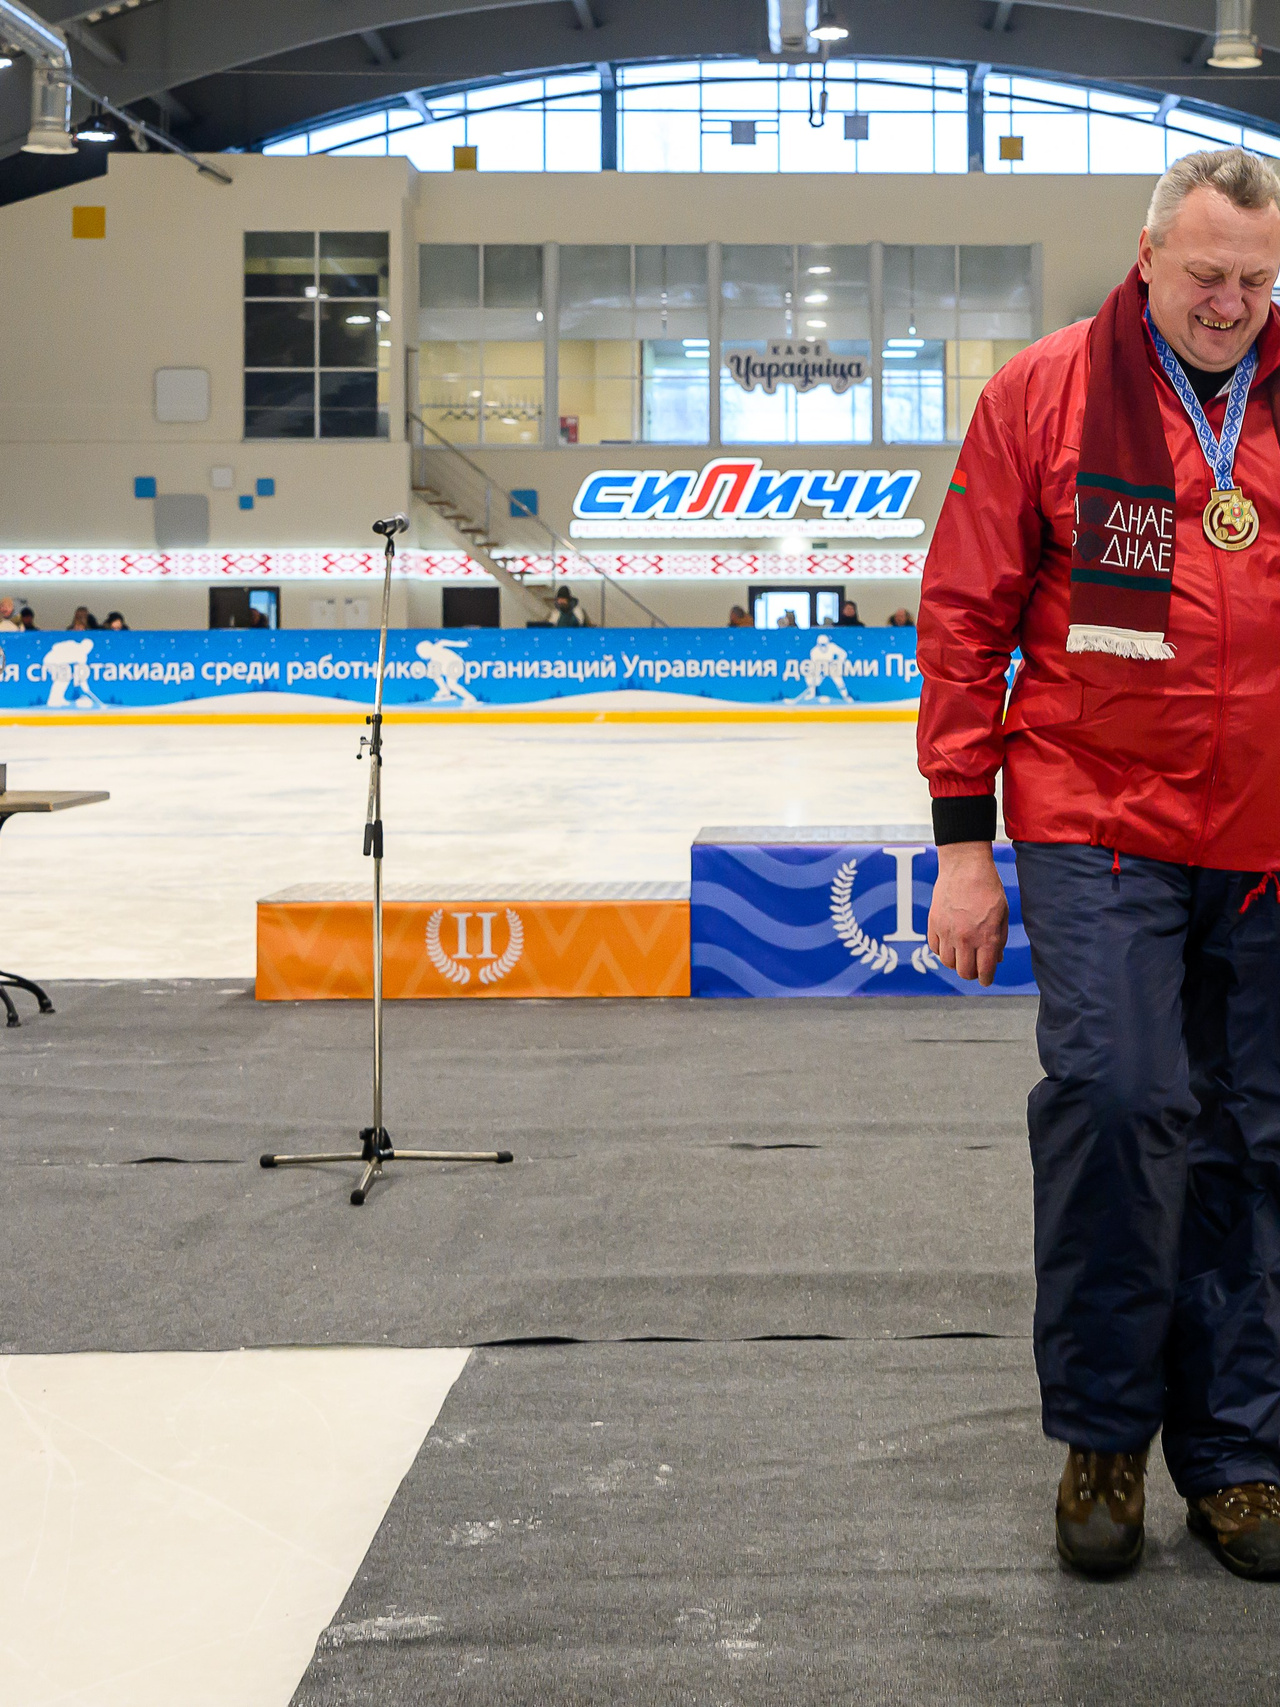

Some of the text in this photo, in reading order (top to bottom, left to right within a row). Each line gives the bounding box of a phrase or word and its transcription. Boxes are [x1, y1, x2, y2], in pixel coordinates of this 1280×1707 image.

[772, 345, 821, 356] КАФЕ
[26, 661, 195, 686] спартакиада
[201, 661, 280, 686] среди
[449, 654, 616, 686] организаций
[621, 654, 778, 684] Управления
[782, 658, 879, 682] делами
[451, 911, 498, 959] II
